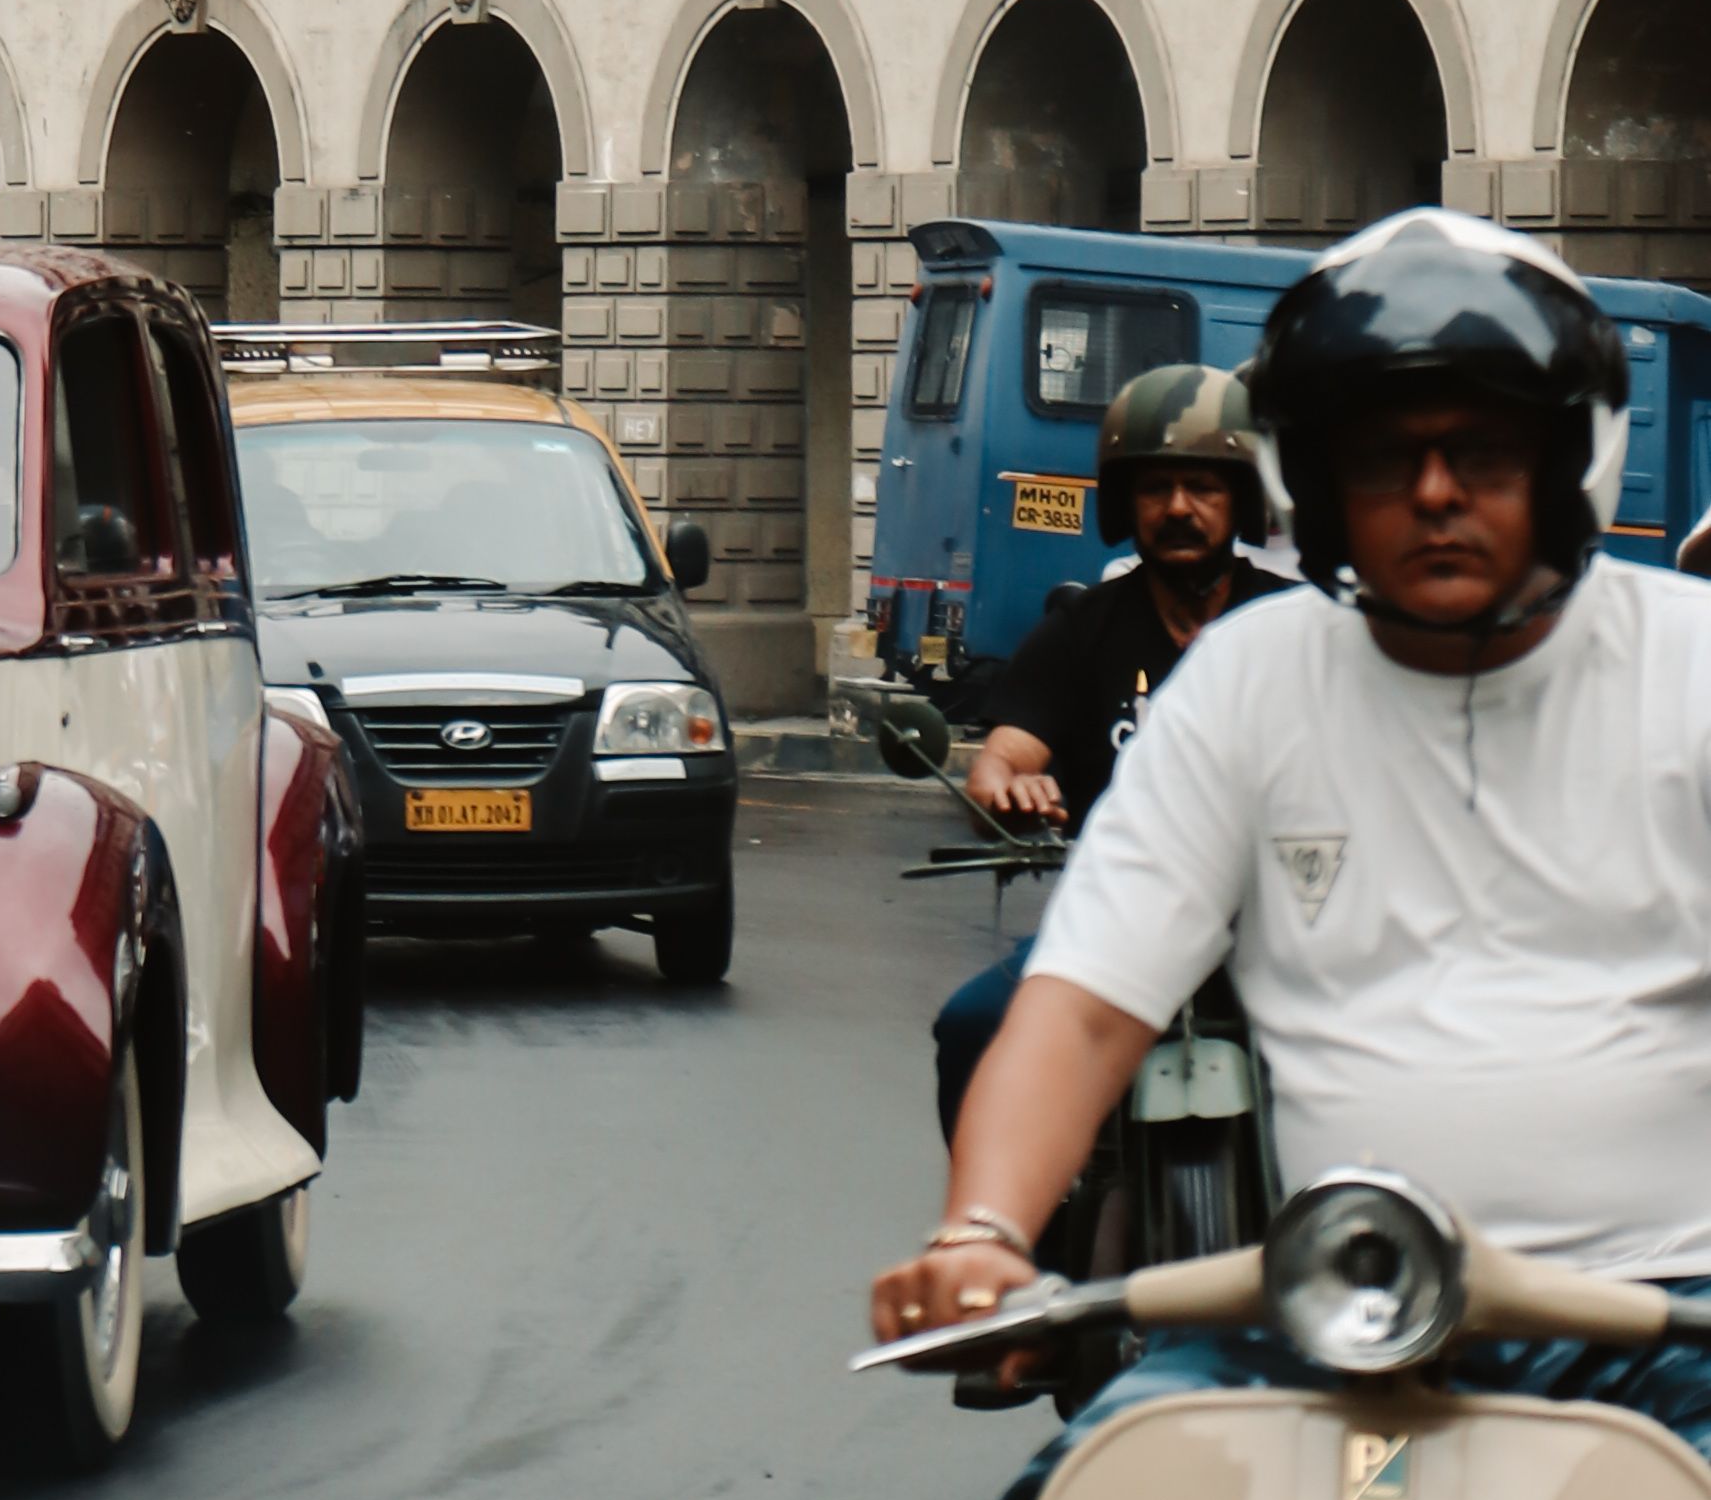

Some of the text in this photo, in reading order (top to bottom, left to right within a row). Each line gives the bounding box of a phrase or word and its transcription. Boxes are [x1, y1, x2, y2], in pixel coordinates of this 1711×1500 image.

[624, 416, 657, 440] HEY
[1019, 488, 1076, 508] MH-01
[1016, 507, 1081, 529] CR-3833
